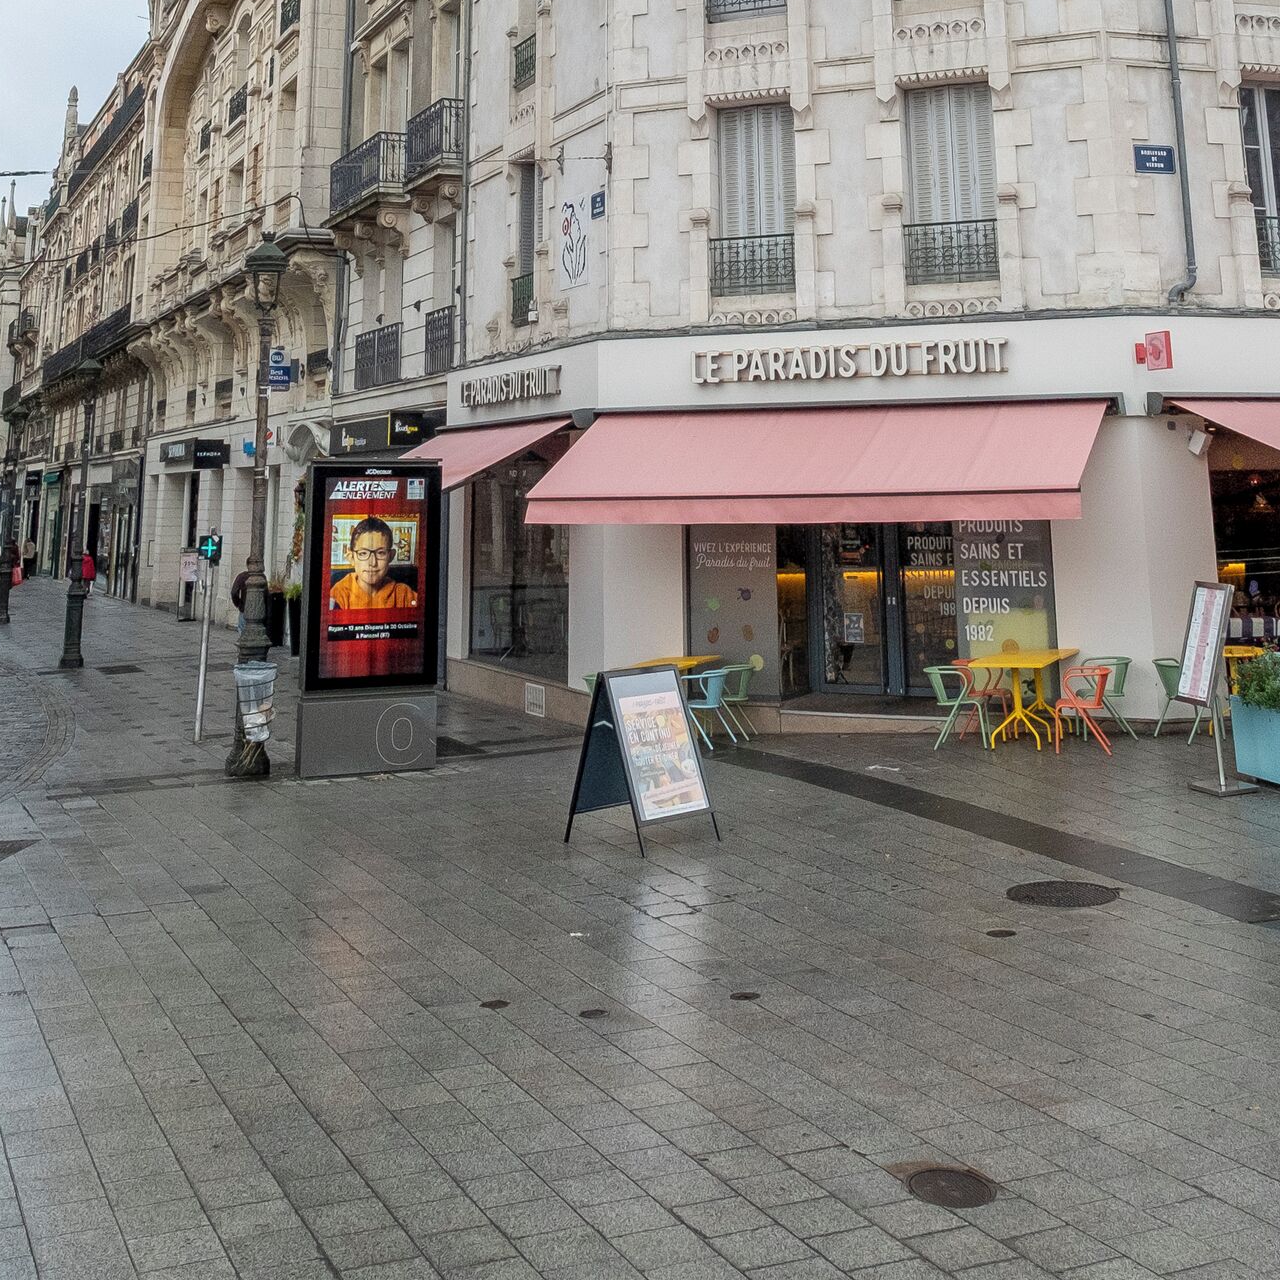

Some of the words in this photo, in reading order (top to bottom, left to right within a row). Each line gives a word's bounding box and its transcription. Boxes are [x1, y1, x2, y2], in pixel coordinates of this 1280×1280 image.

[691, 351, 720, 384] LE
[732, 344, 858, 381] PARADIS
[870, 342, 907, 376] DU
[921, 338, 1007, 375] FRUIT
[470, 374, 507, 406] PARADIS
[509, 371, 521, 401] DU
[524, 366, 551, 398] FRUIT
[958, 520, 1024, 533] PRODUITS
[693, 542, 716, 553] VIVEZ
[718, 540, 772, 553] L'EXPÉRIENCE
[907, 536, 953, 550] PRODUIT
[910, 552, 943, 567] SAINS
[946, 552, 953, 566] E
[960, 543, 1000, 560] SAINS
[1008, 543, 1024, 559] ET
[695, 553, 735, 569] Paradis
[961, 570, 1048, 587] ESSENTIELS
[923, 585, 955, 599] DEPUI
[939, 601, 956, 616] 198
[963, 597, 1010, 614] DEPUIS
[964, 624, 994, 642] 1982
[625, 716, 657, 732] SERVICE
[628, 731, 639, 744] EN
[640, 727, 671, 743] CONTINU
